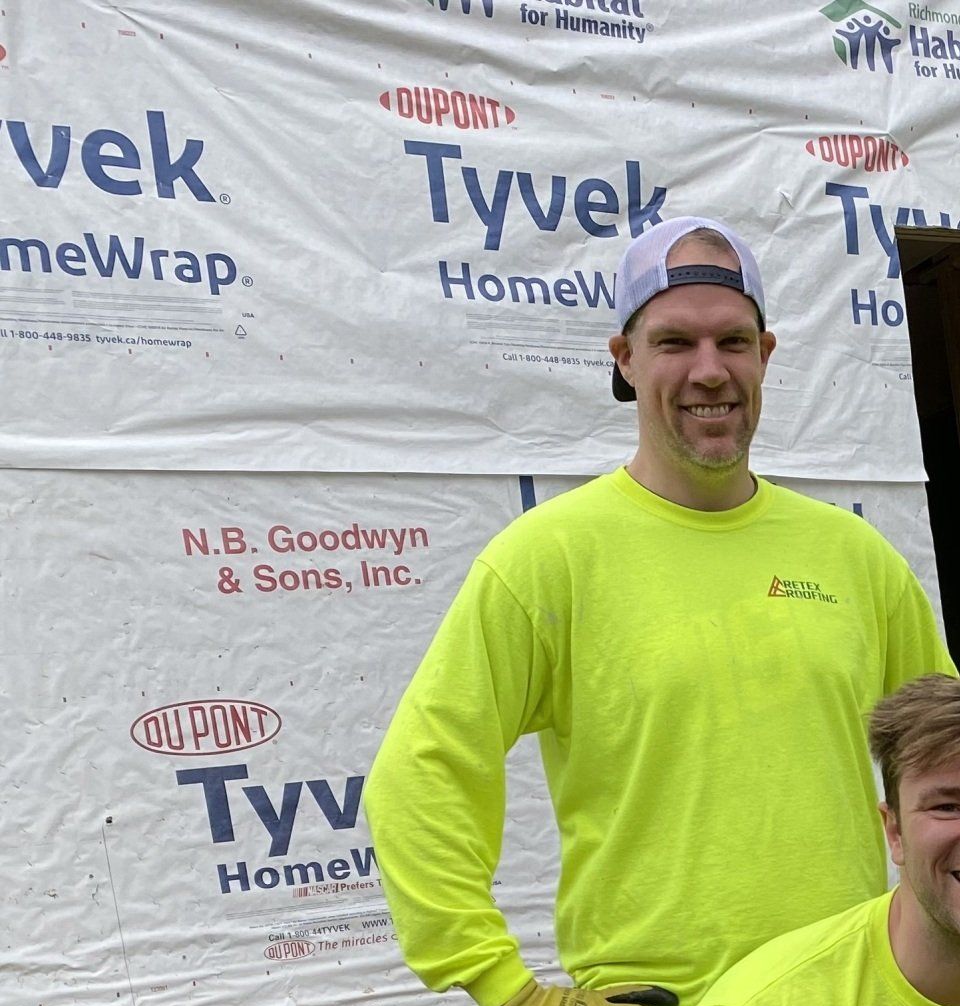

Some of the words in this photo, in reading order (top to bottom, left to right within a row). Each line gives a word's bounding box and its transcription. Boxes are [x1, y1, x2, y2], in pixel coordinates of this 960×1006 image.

[520, 3, 549, 26] for
[555, 8, 646, 43] Humanity
[914, 61, 938, 79] for
[396, 87, 501, 130] DUPONT
[0, 110, 217, 203] vek
[818, 134, 899, 172] DUPONT
[403, 140, 668, 251] Tyvek
[0, 232, 237, 295] meWrap
[438, 260, 616, 309] HomeW
[10, 329, 92, 342] 1-800-448-9835
[95, 334, 193, 348] tyvek.ca/homewrap
[503, 353, 518, 362] Call
[520, 354, 581, 366] 1-800-448-9835
[182, 526, 259, 556] N.B.
[267, 523, 430, 556] Goodwyn
[217, 566, 244, 594] &
[253, 562, 353, 593] Sons,
[361, 559, 422, 587] Inc.
[786, 589, 838, 604] ROOFING
[175, 763, 366, 857] Tyv
[216, 847, 379, 894] HomeW
[340, 880, 375, 892] Prefers
[268, 932, 285, 942] Call
[318, 940, 338, 951] The
[341, 934, 388, 947] miracles
